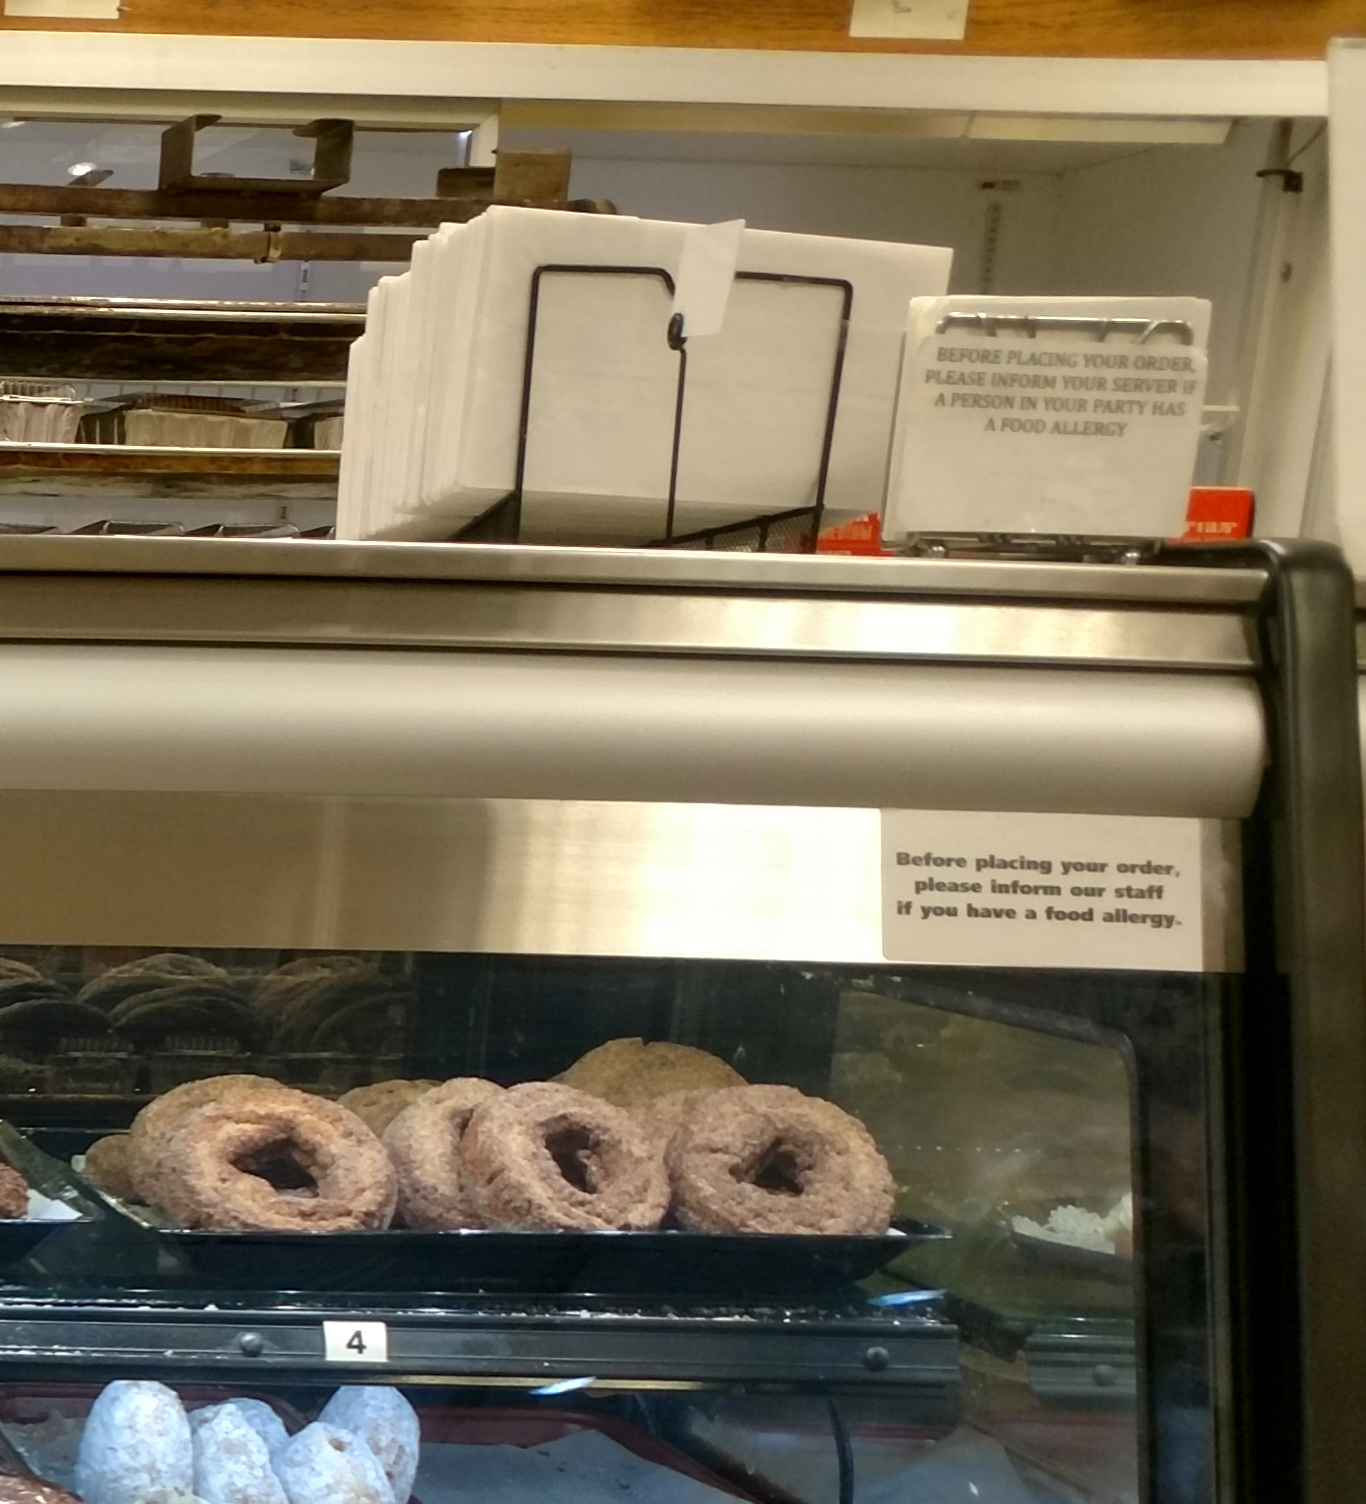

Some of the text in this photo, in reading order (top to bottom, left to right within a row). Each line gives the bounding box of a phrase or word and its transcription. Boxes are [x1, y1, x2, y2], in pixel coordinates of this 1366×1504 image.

[937, 347, 1003, 365] BEFORE
[1006, 350, 1078, 368] PLACING
[1083, 353, 1129, 369] YOUR
[925, 369, 1197, 395] PLEASE INFORM YOUR SERVER IF
[934, 392, 1186, 417] A PERSON IN YOUR PARTY HAS
[984, 417, 1128, 437] A FOOD ALLERGY
[896, 852, 1180, 878] Before placing your order,
[915, 878, 1165, 900] please inform our staff
[897, 901, 1183, 929] if you have a food allergy.
[347, 1331, 367, 1355] 4
